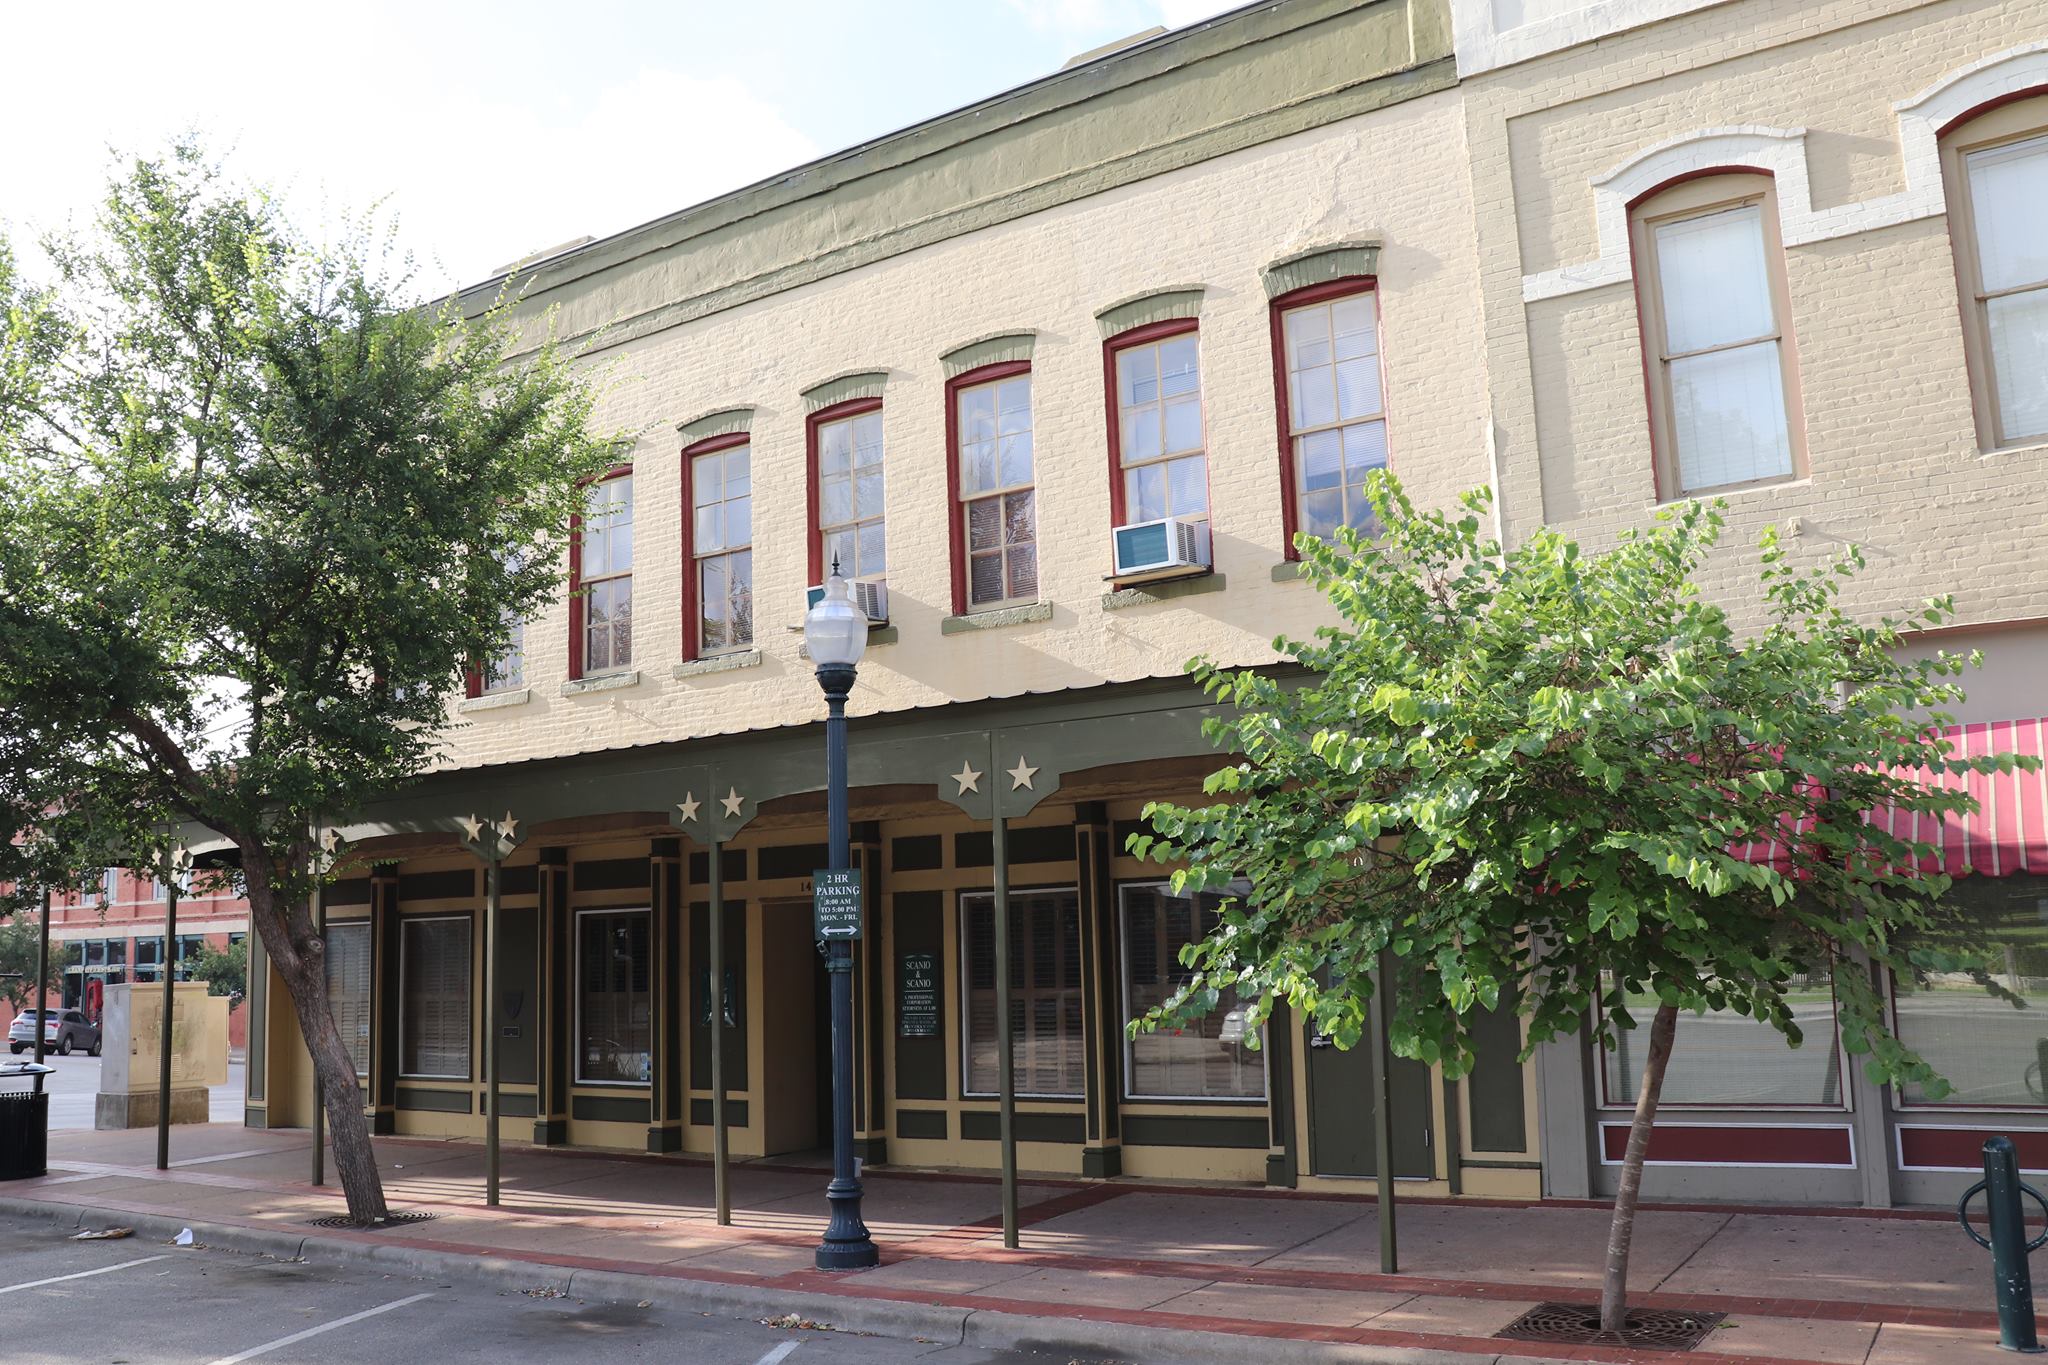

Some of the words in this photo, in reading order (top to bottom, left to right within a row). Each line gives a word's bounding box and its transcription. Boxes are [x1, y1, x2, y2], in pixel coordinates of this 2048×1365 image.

[827, 874, 832, 884] 2
[834, 874, 848, 883] HR
[816, 886, 860, 896] PARKING
[906, 960, 931, 970] SCANIO
[906, 979, 931, 988] SCANIO
